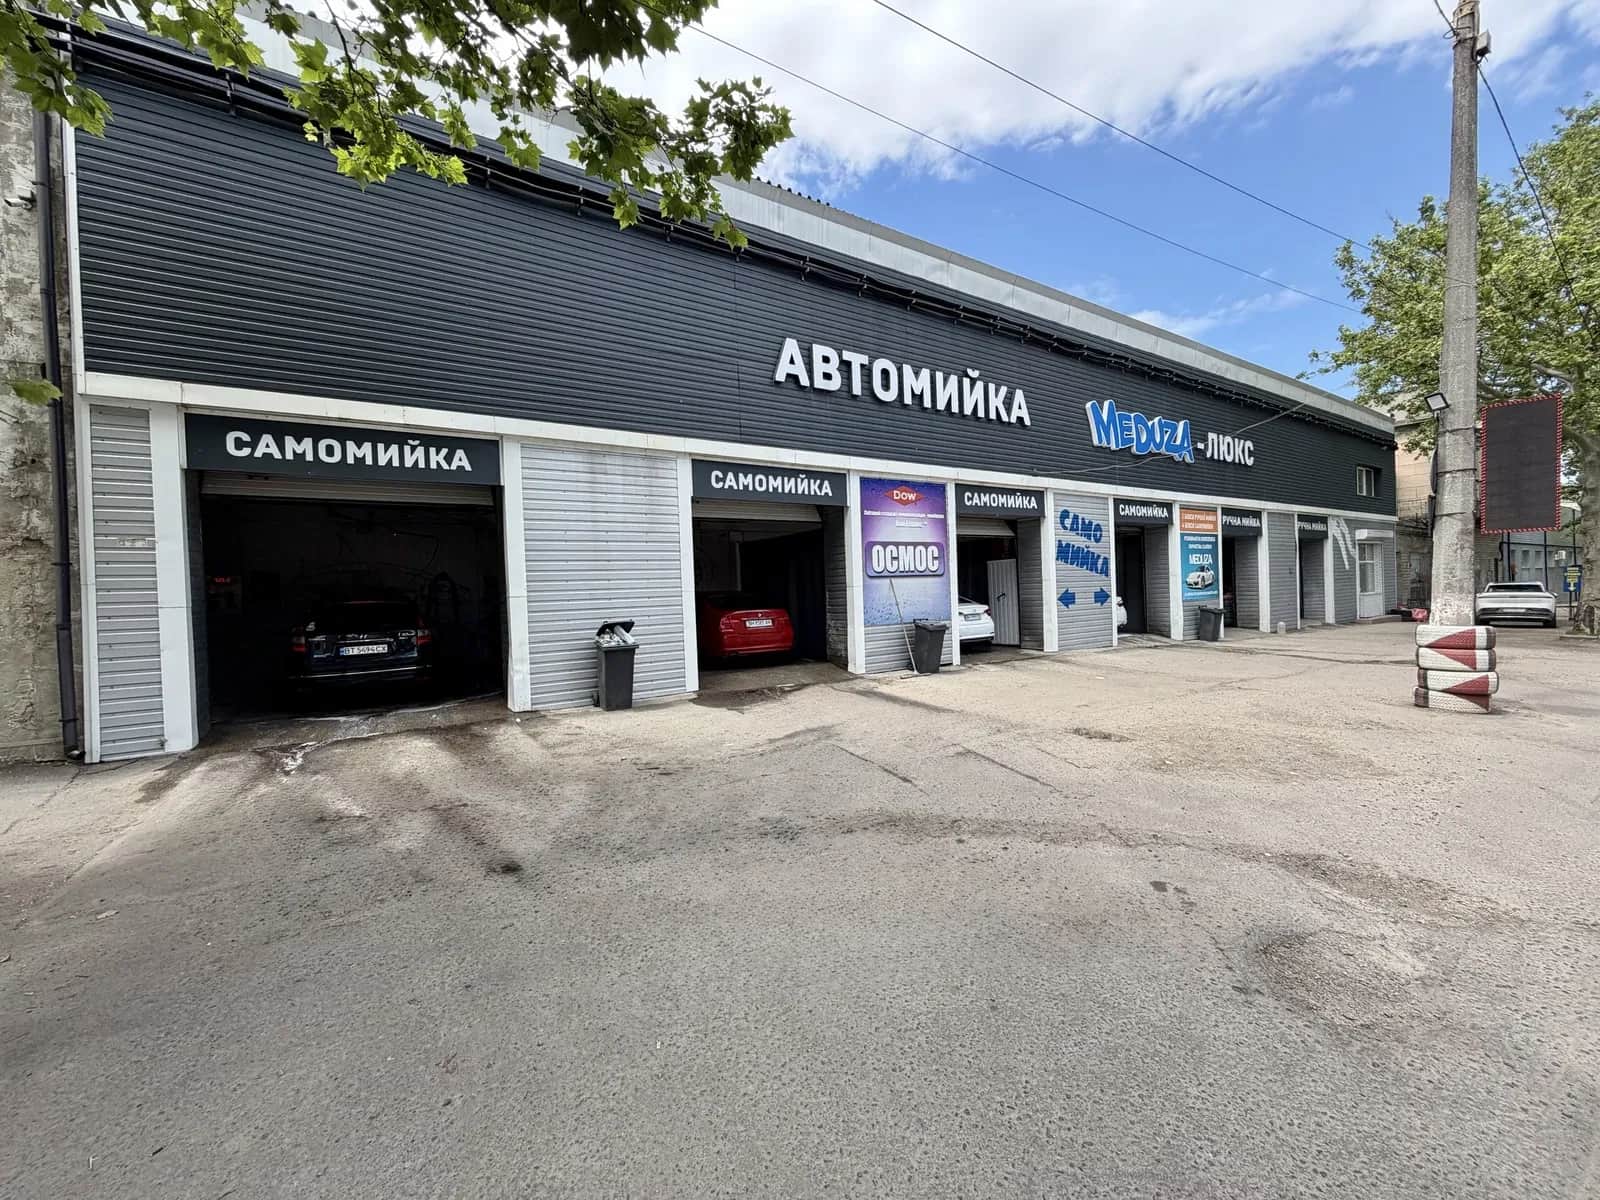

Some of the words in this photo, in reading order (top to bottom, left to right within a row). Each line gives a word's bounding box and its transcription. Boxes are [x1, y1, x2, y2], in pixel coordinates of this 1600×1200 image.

[774, 337, 1031, 426] АВТОМИЙКА
[225, 430, 472, 471] САМОМИЙКА
[711, 470, 833, 497] САМОМИЙКА
[964, 491, 1038, 510] САМОМИЙКА
[1119, 504, 1169, 518] САМОМИЙКА
[1059, 509, 1103, 543] САМО
[872, 545, 939, 573] ОСМОС
[1056, 539, 1109, 577] МИЙКА
